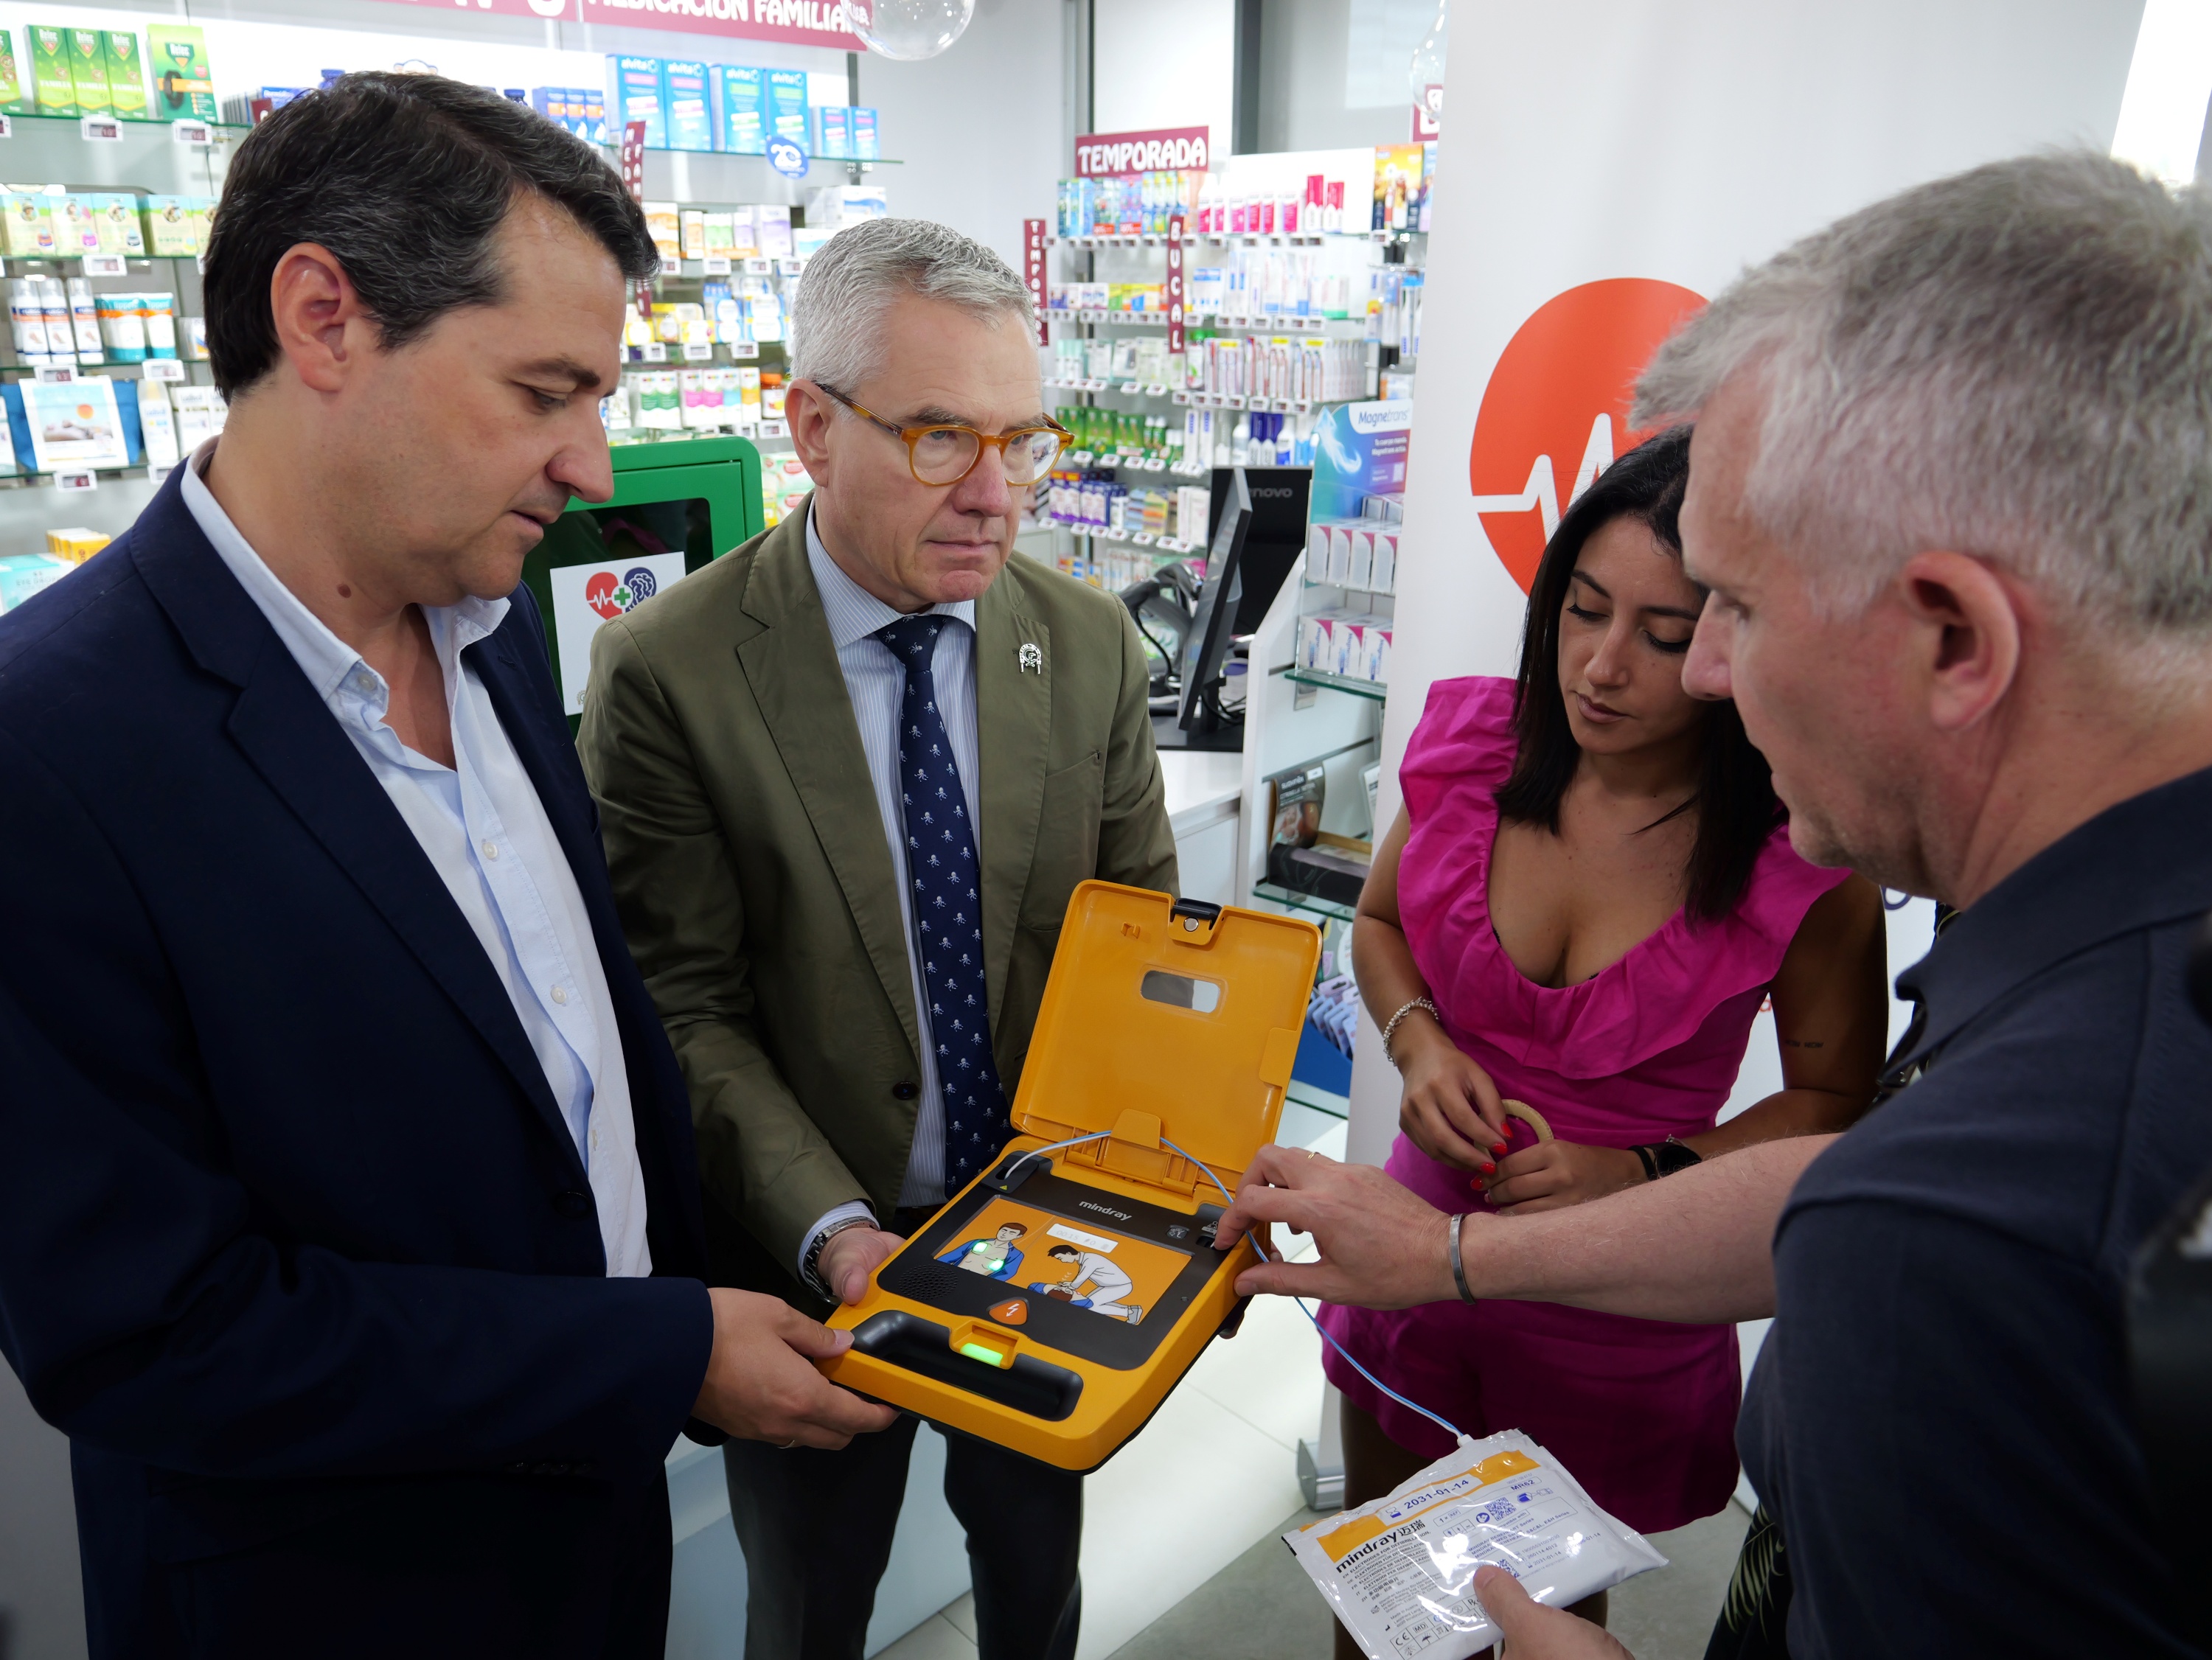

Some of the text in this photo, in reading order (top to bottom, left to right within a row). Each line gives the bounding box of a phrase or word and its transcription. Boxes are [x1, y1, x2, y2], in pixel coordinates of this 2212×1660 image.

[1077, 136, 1207, 174] TEMPORADA
[1169, 221, 1182, 349] BUCAL
[1358, 409, 1408, 426] Magnetrans
[1251, 487, 1293, 498] novo
[1079, 1201, 1132, 1221] mindray
[1404, 1479, 1469, 1509] 2031-01-14
[1511, 1479, 1535, 1490] MR62
[1555, 1510, 1570, 1519] Series
[1336, 1532, 1397, 1573] mindray
[1397, 1519, 1426, 1536] 迈瑞
[1468, 1538, 1489, 1551] MINDRAY
[1519, 1517, 1534, 1527] Series
[1349, 1552, 1380, 1573] ELECTRODES
[1391, 1530, 1430, 1548] DEFIBRILLAION,
[1354, 1560, 1382, 1579] ELEKTRODEN
